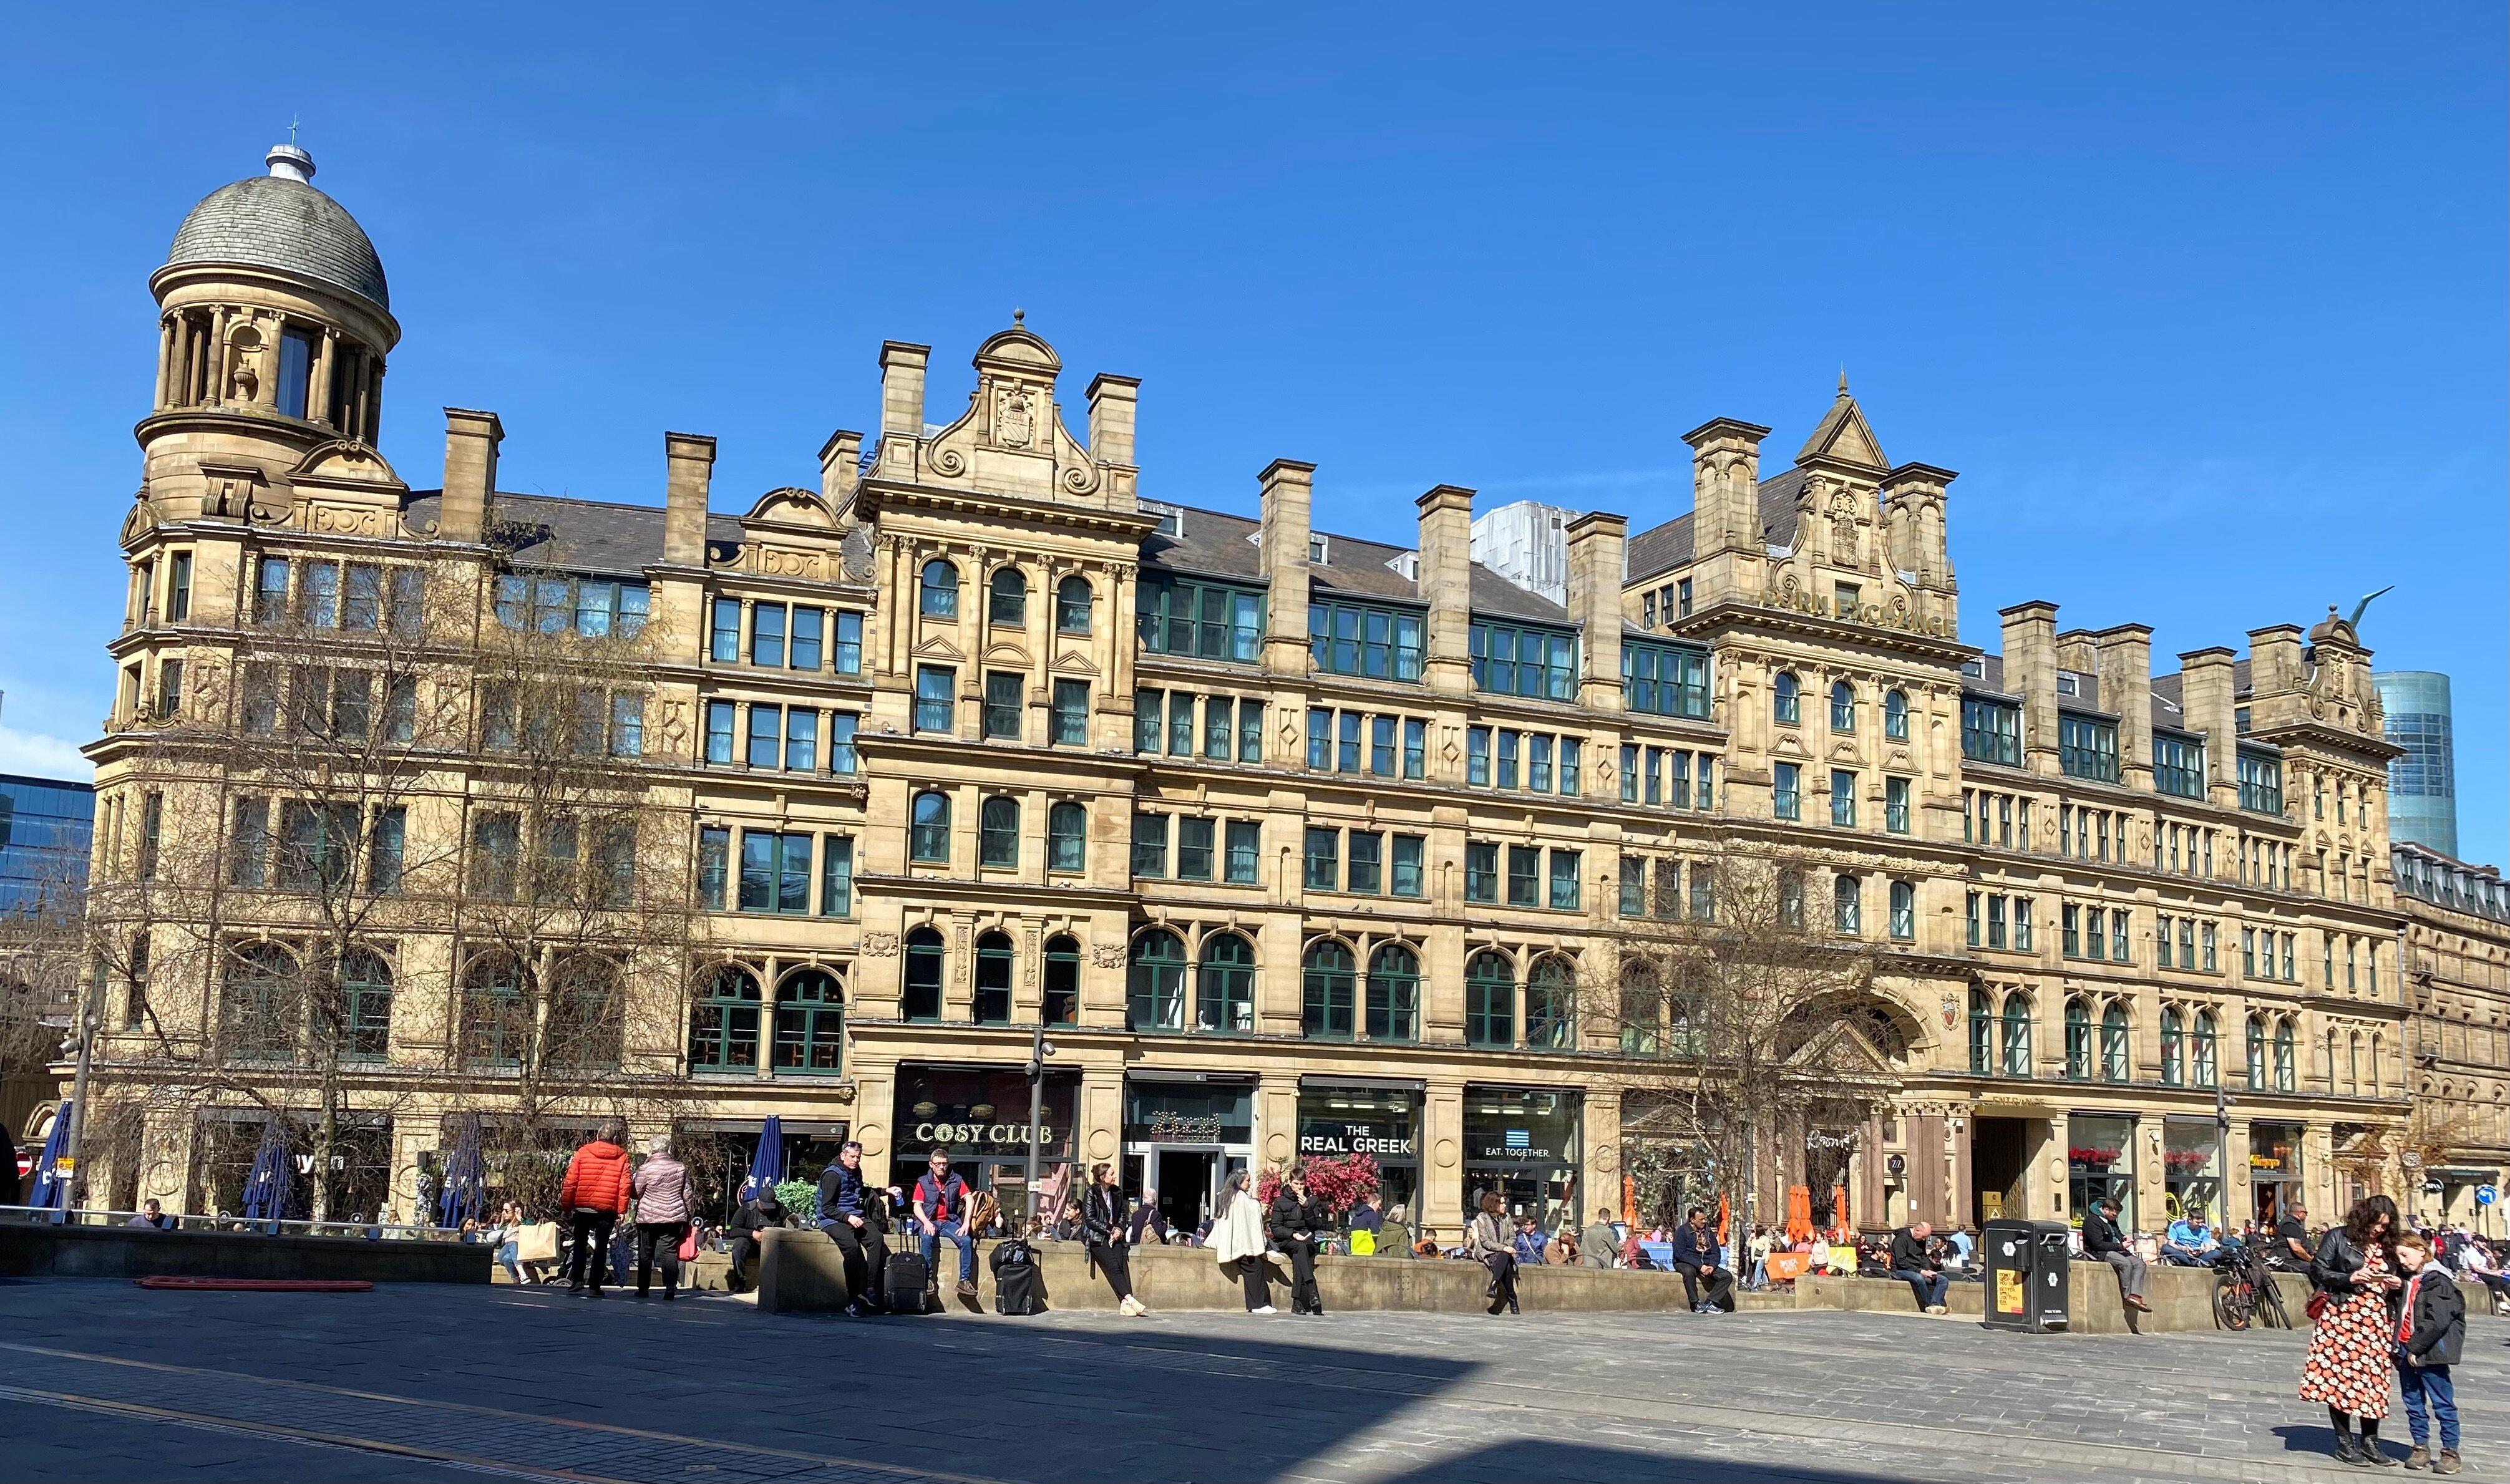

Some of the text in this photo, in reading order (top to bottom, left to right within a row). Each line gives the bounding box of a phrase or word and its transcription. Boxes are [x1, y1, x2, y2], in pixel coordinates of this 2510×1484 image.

[1759, 586, 1958, 638] CORN EXCHANGE
[916, 1123, 1052, 1144] COSY CLUB
[1345, 1125, 1369, 1137] THE
[1301, 1136, 1411, 1154] REAL GREEK
[1486, 1147, 1551, 1158] EAT. TOGETHER.
